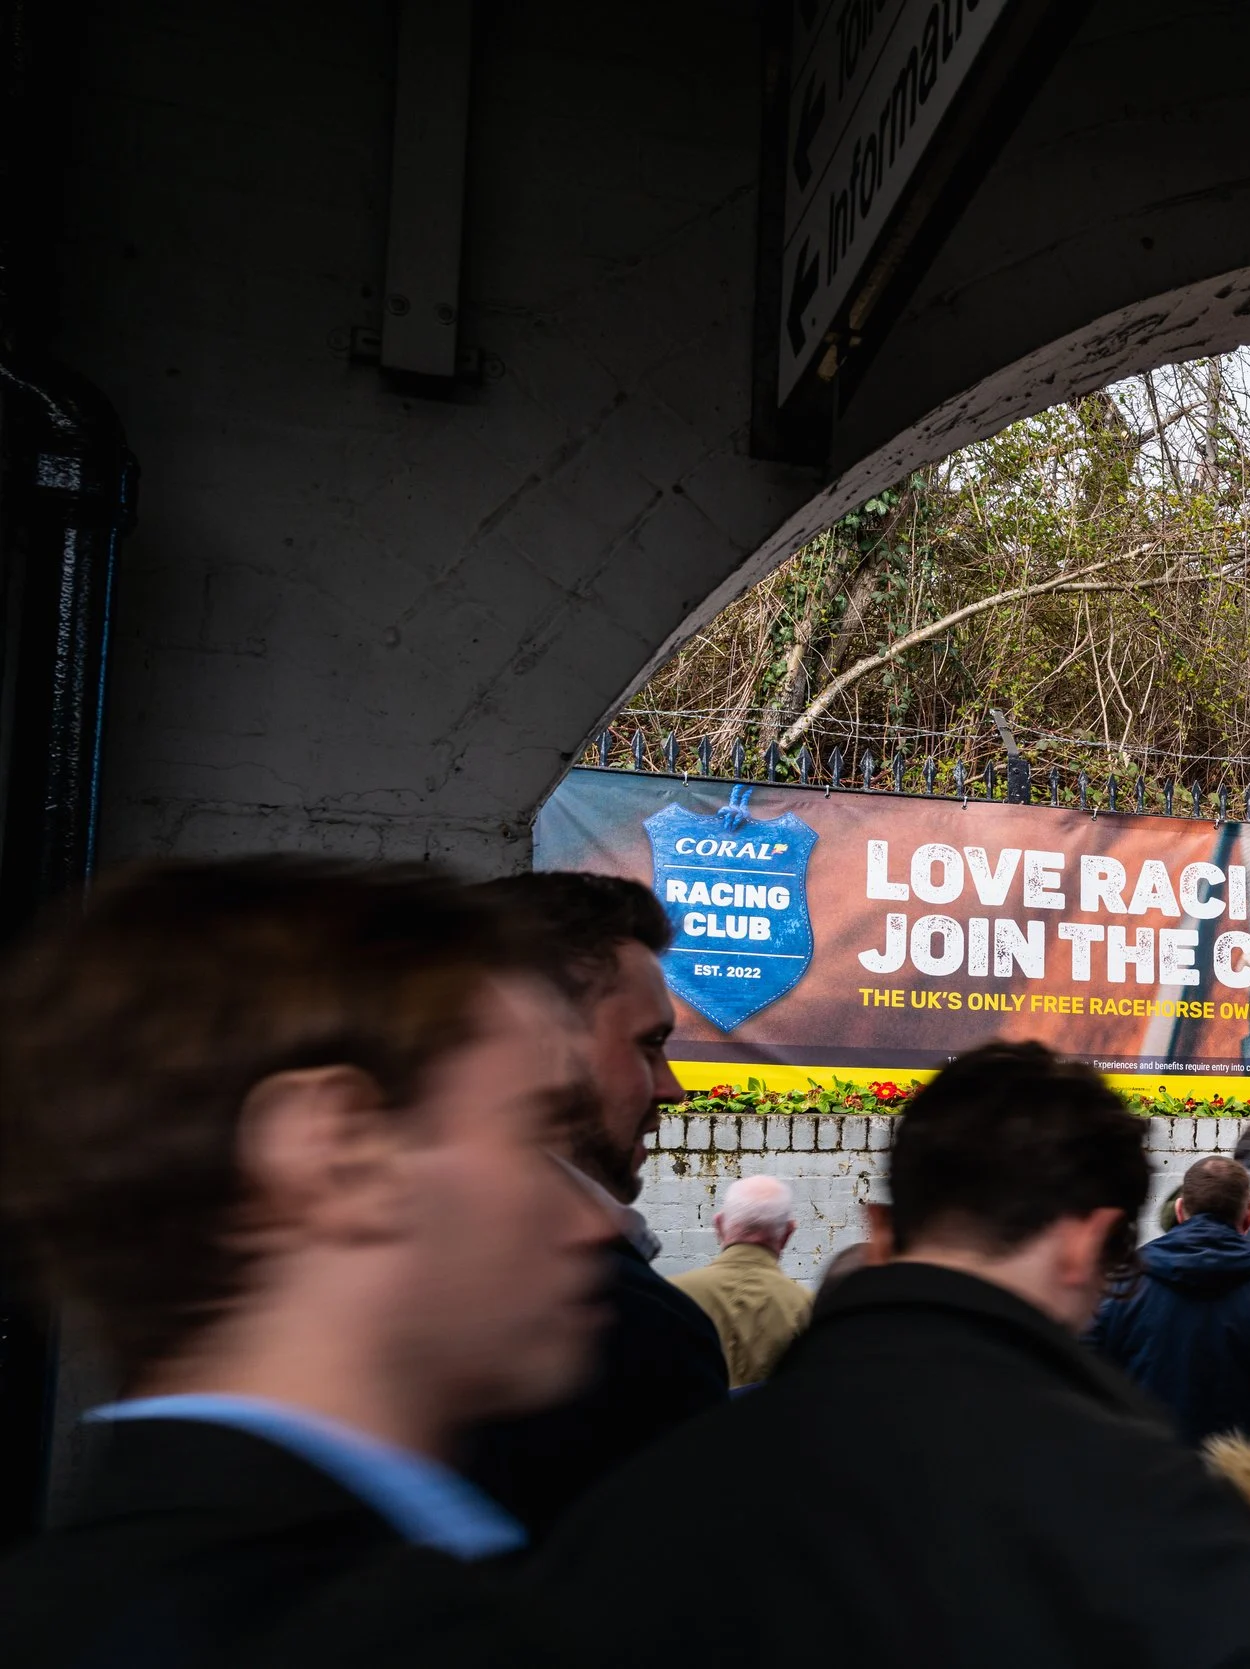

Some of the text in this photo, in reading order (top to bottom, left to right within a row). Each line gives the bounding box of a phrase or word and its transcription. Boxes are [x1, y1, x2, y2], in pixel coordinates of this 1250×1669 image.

[827, 0, 979, 286] Informat
[674, 838, 773, 860] CORAL
[866, 839, 1065, 910] LOVE
[666, 880, 790, 910] RACING
[683, 913, 771, 941] CLUB
[858, 912, 1046, 979] JOIN
[1058, 923, 1200, 986] THE
[694, 964, 761, 979] EST. 2022
[859, 988, 905, 1008] THE
[911, 990, 962, 1010] UK'S
[967, 992, 1026, 1012] ONLY
[1030, 994, 1084, 1014] FREE
[1089, 997, 1215, 1019] RACEHORSE
[1093, 1059, 1138, 1070] Experiences
[1139, 1062, 1154, 1070] and
[1155, 1061, 1184, 1071] benefits
[1185, 1062, 1210, 1073] require
[1211, 1063, 1229, 1073] entry
[1231, 1064, 1245, 1072] into
